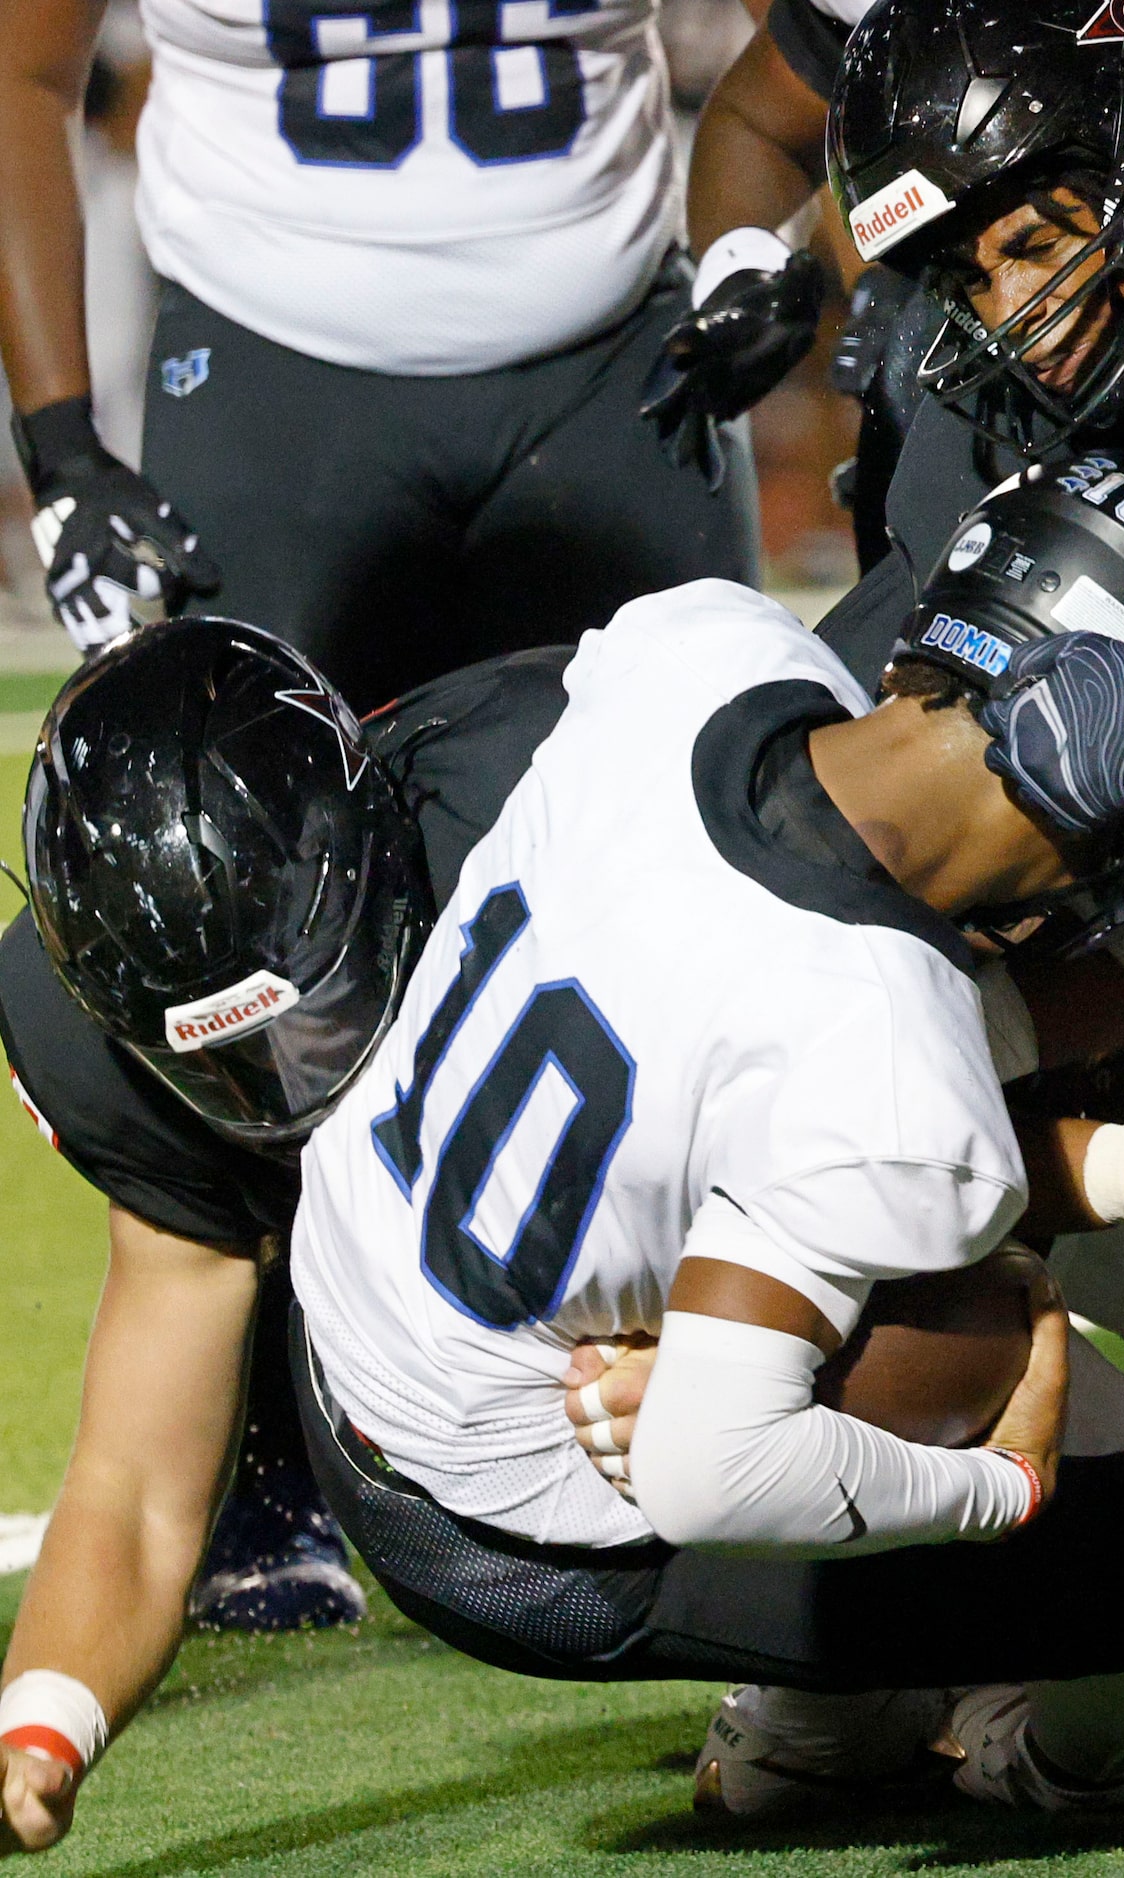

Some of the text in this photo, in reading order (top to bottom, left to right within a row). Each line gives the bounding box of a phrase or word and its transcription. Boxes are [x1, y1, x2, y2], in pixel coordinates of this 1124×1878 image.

[854, 186, 924, 246] Riddell
[943, 297, 998, 356] Riddel
[174, 986, 279, 1040] Riddell
[370, 880, 637, 1331] 10
